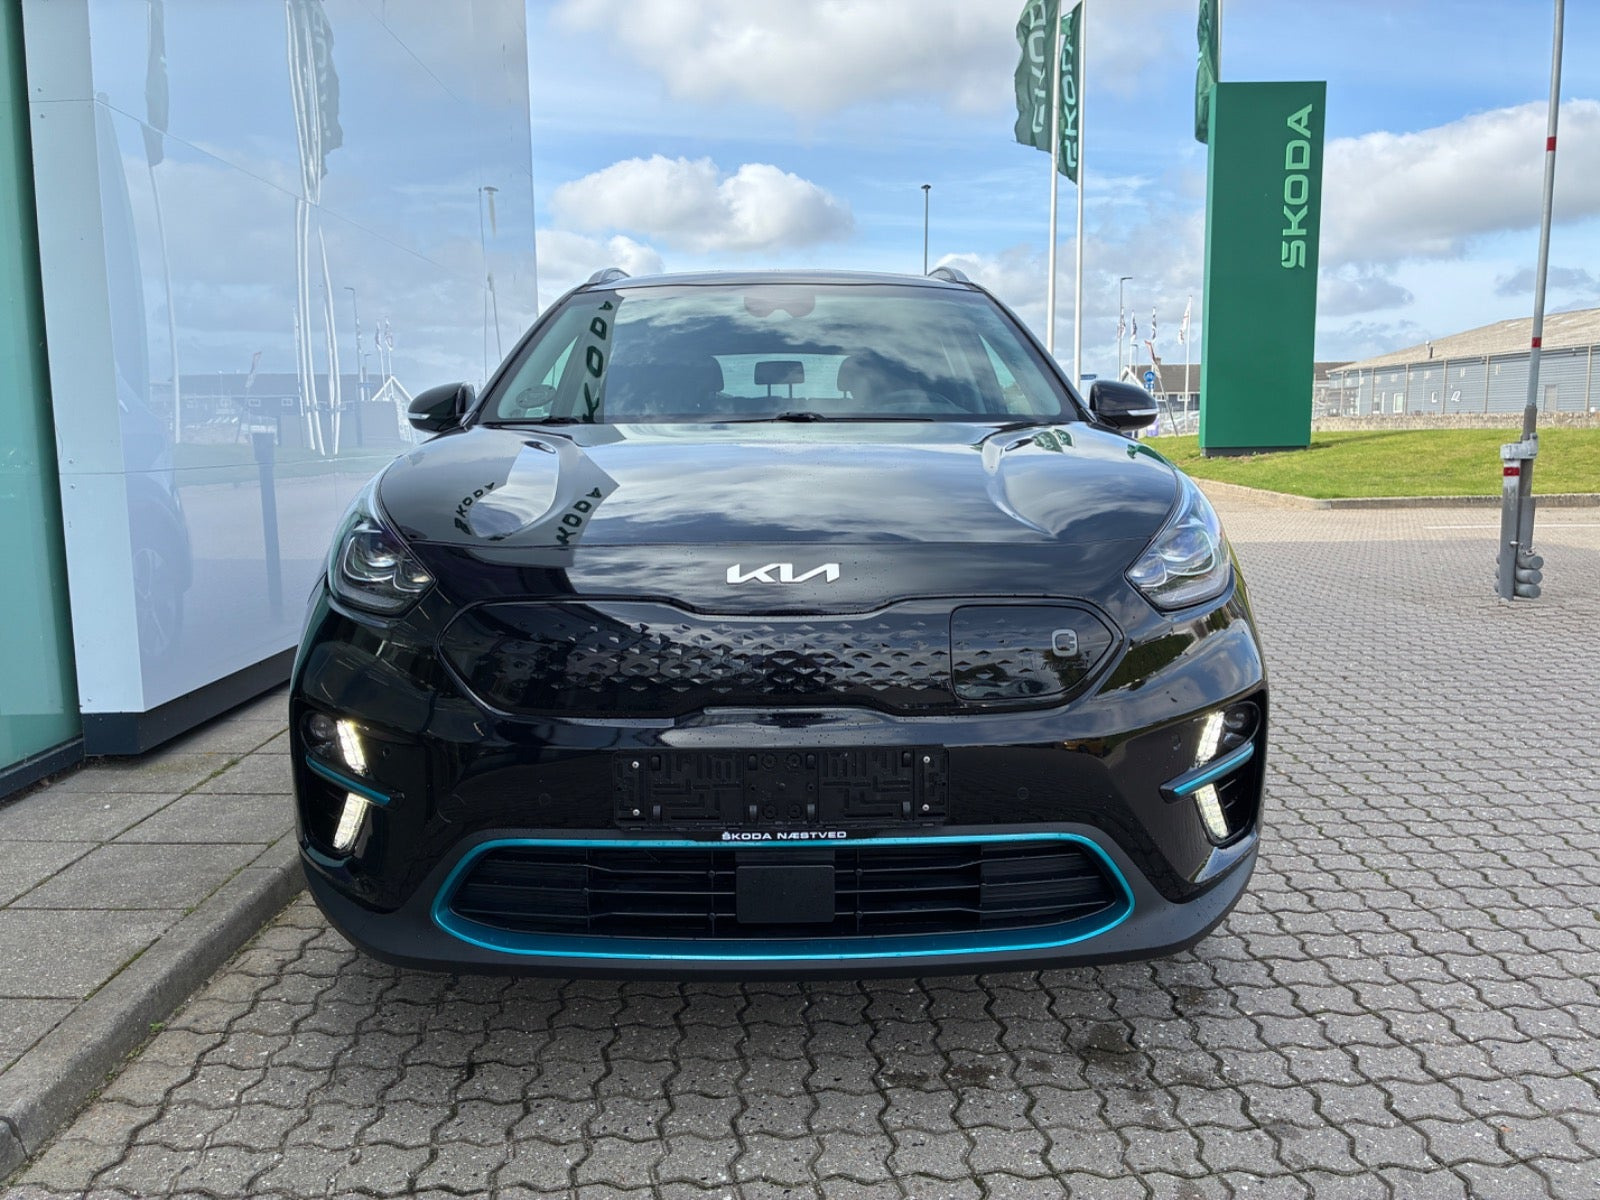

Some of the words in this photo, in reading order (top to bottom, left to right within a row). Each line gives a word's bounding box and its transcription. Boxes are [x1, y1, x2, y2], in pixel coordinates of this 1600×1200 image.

[726, 563, 840, 584] KIA
[721, 831, 772, 840] ŠKODA
[777, 831, 847, 840] NÆSTVED
